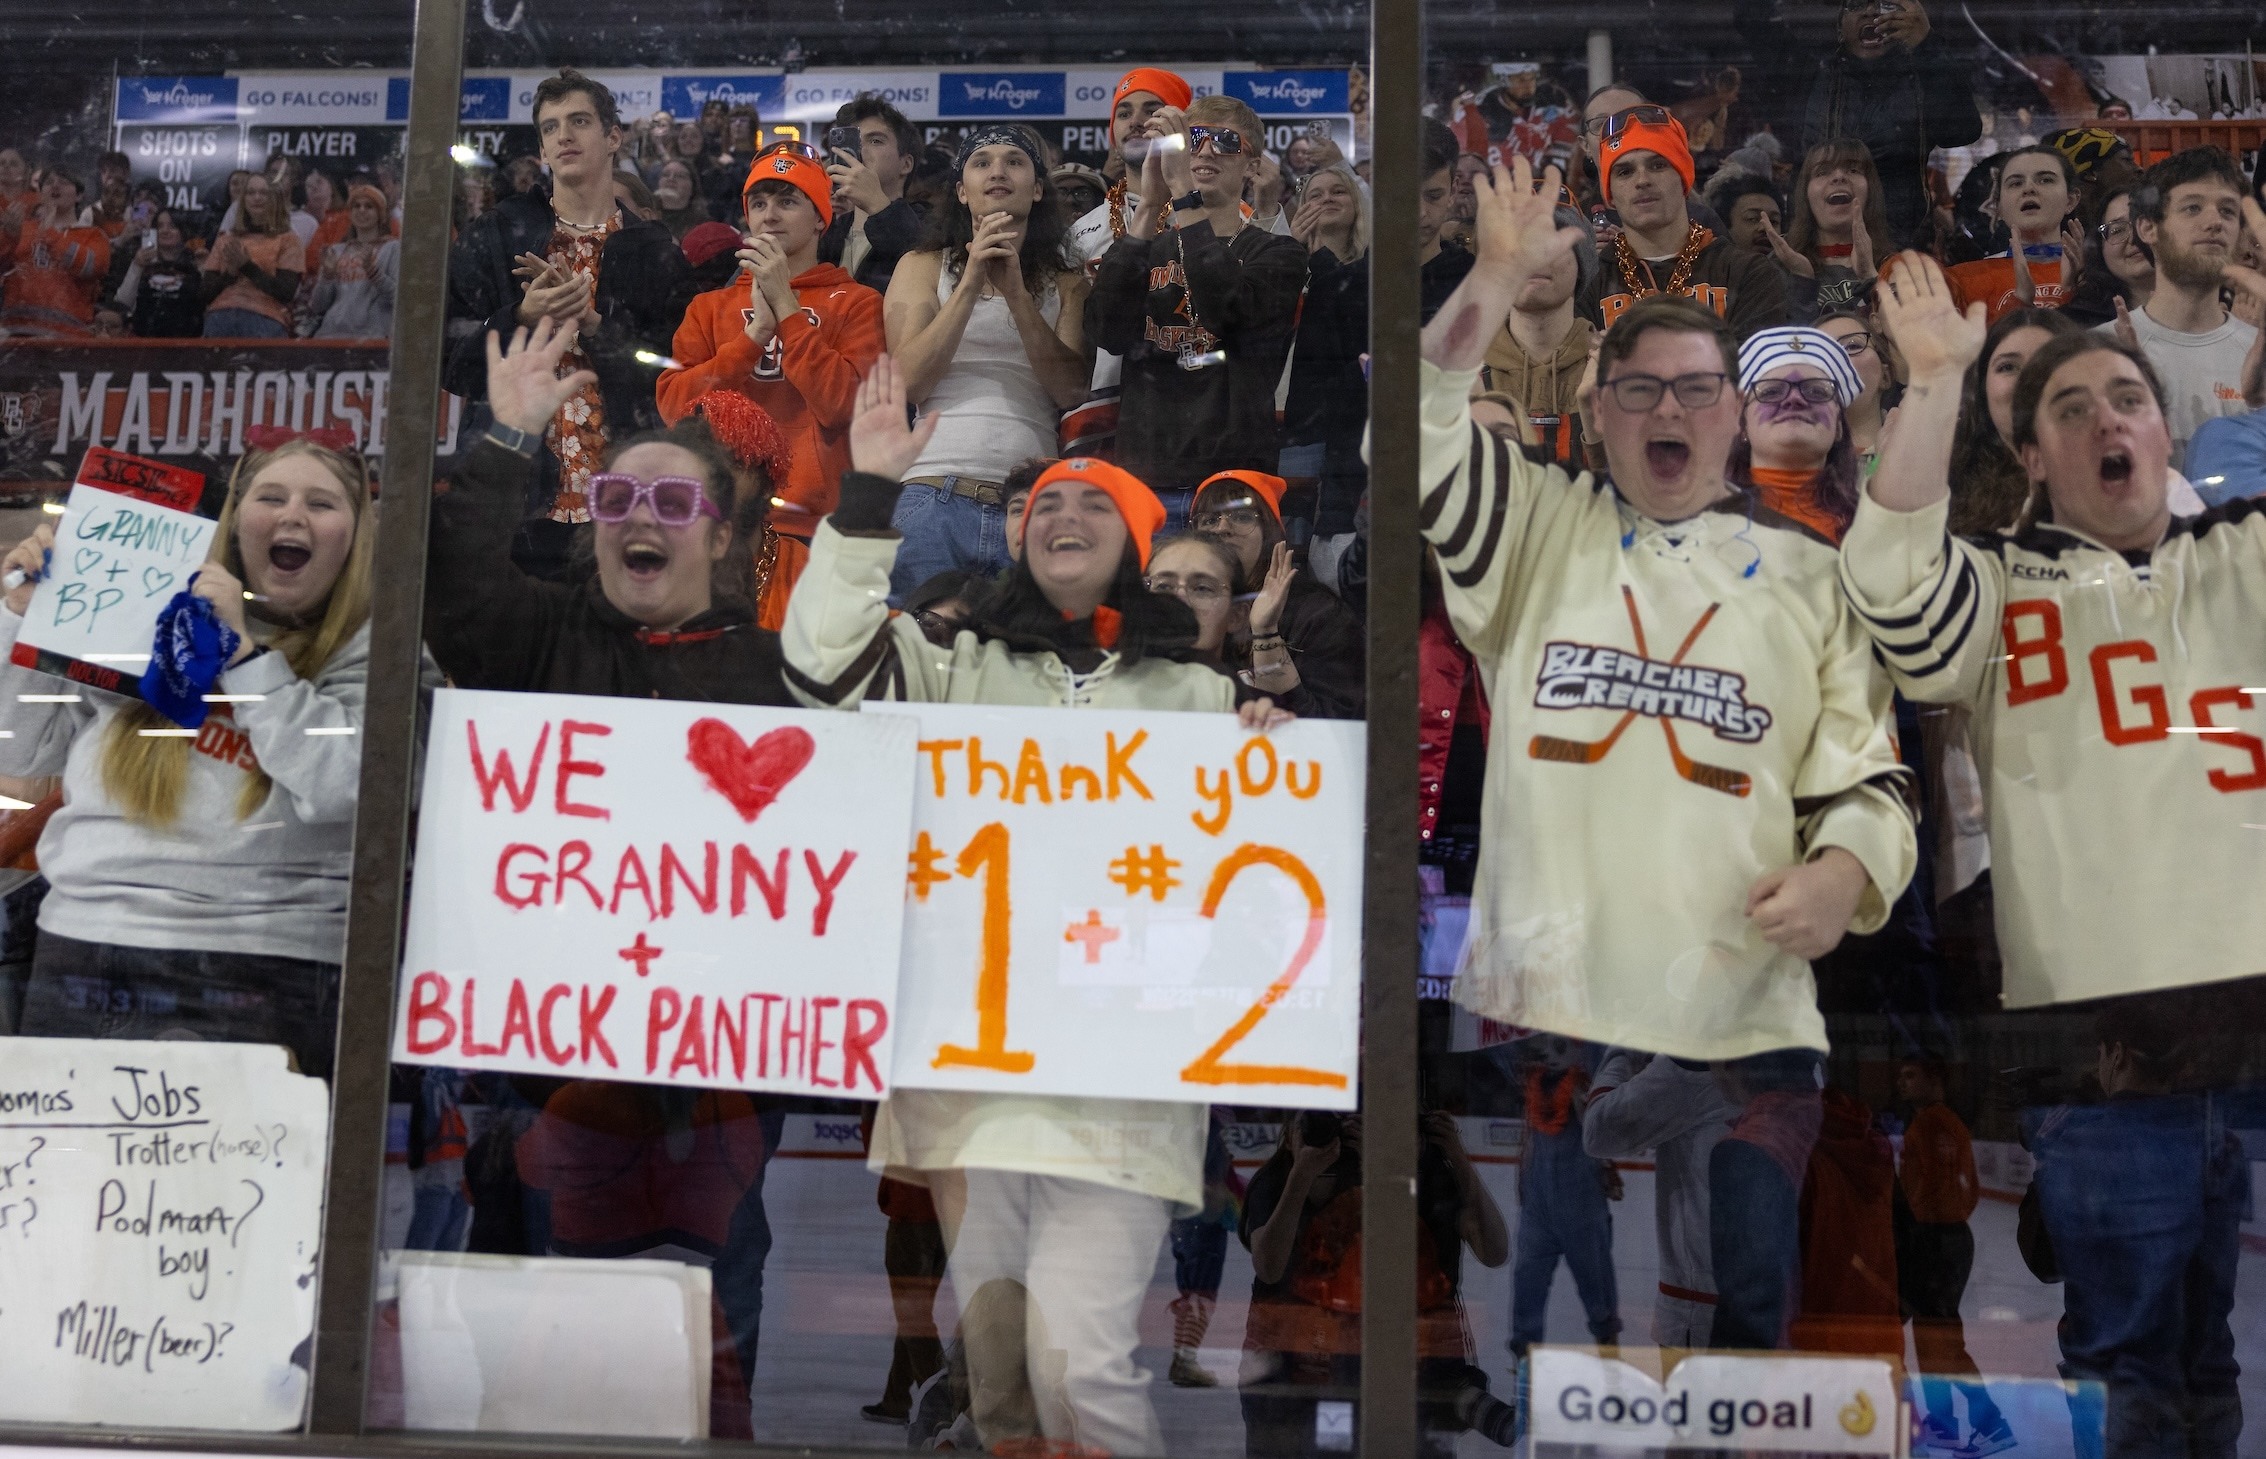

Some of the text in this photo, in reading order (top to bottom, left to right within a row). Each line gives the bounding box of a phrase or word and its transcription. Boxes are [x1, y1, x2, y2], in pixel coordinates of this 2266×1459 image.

[247, 91, 378, 106] GO FALCONS!
[795, 87, 929, 103] GO FACONS!
[988, 80, 1041, 109] Kroger
[1076, 86, 1105, 101] GO
[1273, 79, 1327, 107] Kroger
[140, 131, 217, 156] SHOTS
[267, 132, 357, 156] PLAYER
[159, 158, 192, 183] ON
[76, 506, 203, 562] GRANNY
[2010, 563, 2070, 581] CCHA
[54, 583, 124, 634] BP
[1539, 643, 1745, 704] BLEACHER
[1534, 676, 1771, 741] CREATURES
[466, 719, 613, 822] WE
[494, 840, 858, 937] GRANNY
[406, 970, 889, 1093] BLACK PANTHER
[112, 1065, 201, 1122] Jobs
[159, 1245, 209, 1301] boy
[1558, 1385, 1813, 1436] Good goal
